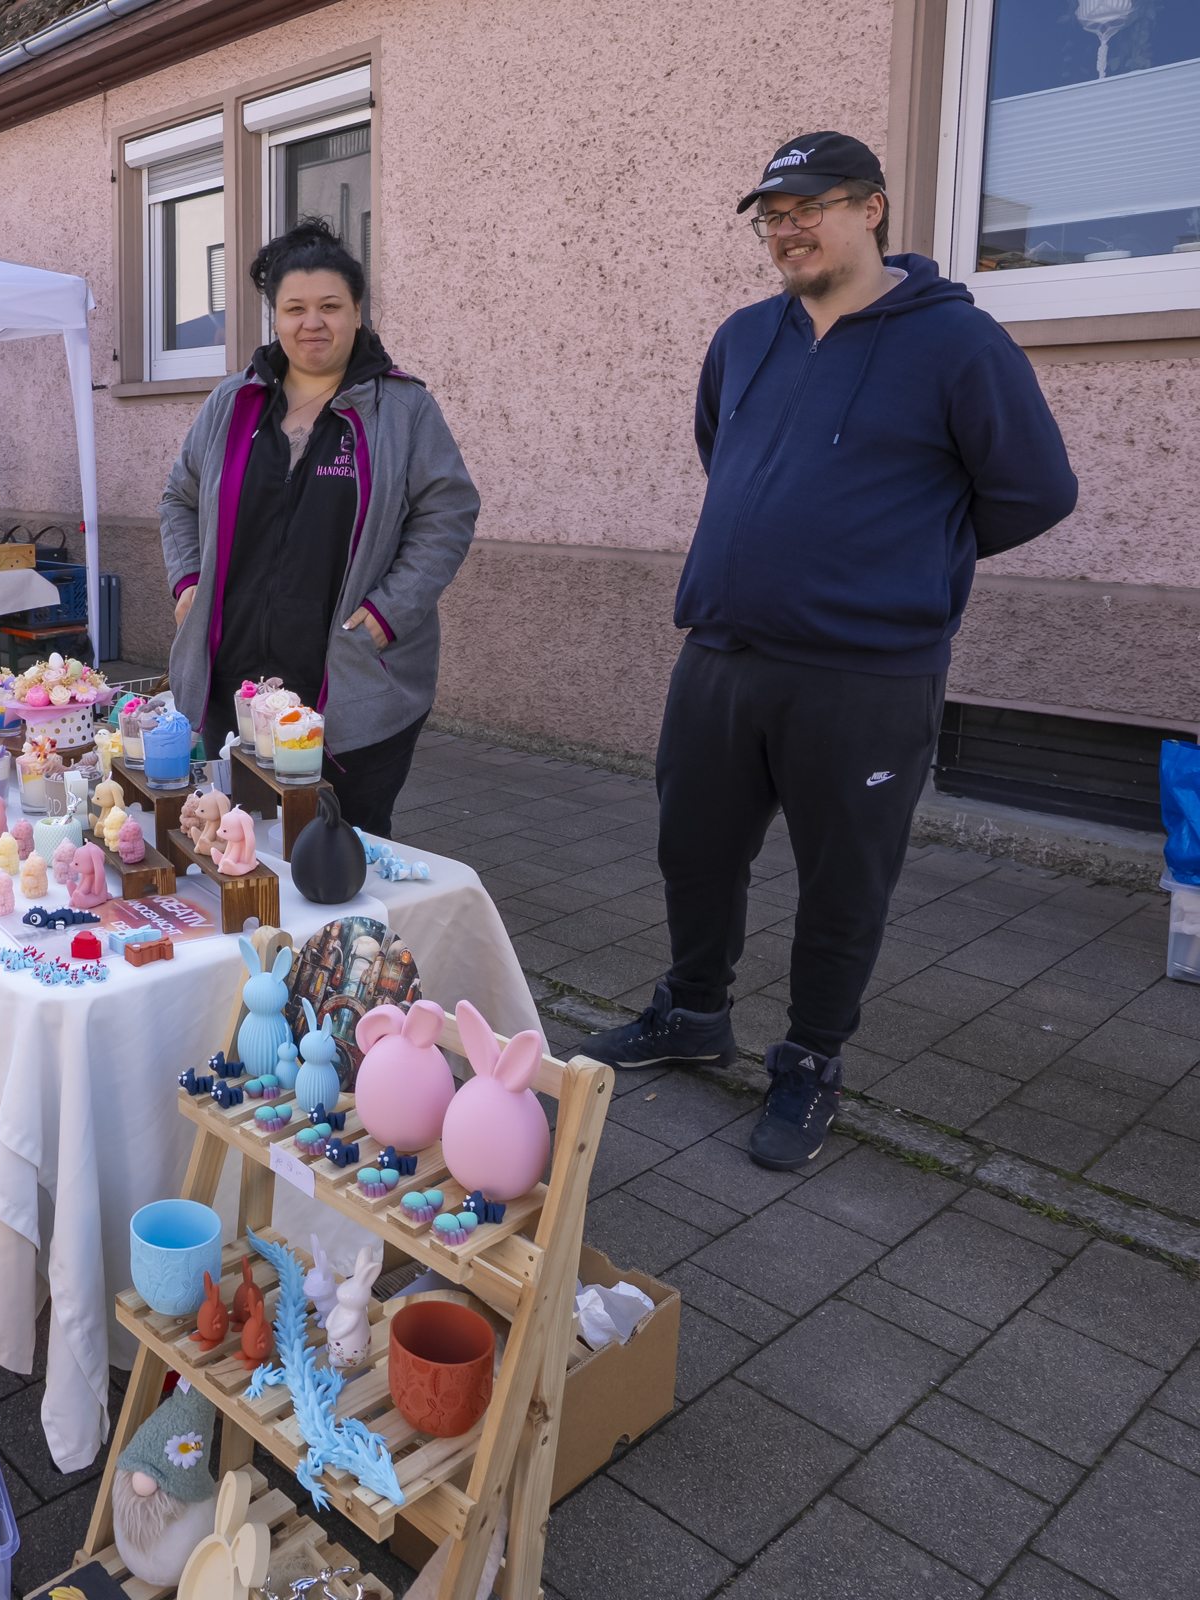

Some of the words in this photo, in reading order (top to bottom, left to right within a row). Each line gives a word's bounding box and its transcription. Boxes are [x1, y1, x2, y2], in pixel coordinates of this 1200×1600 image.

[768, 155, 801, 173] PUMA
[872, 770, 891, 781] NIKE
[123, 899, 184, 936] ANDGEMACHT
